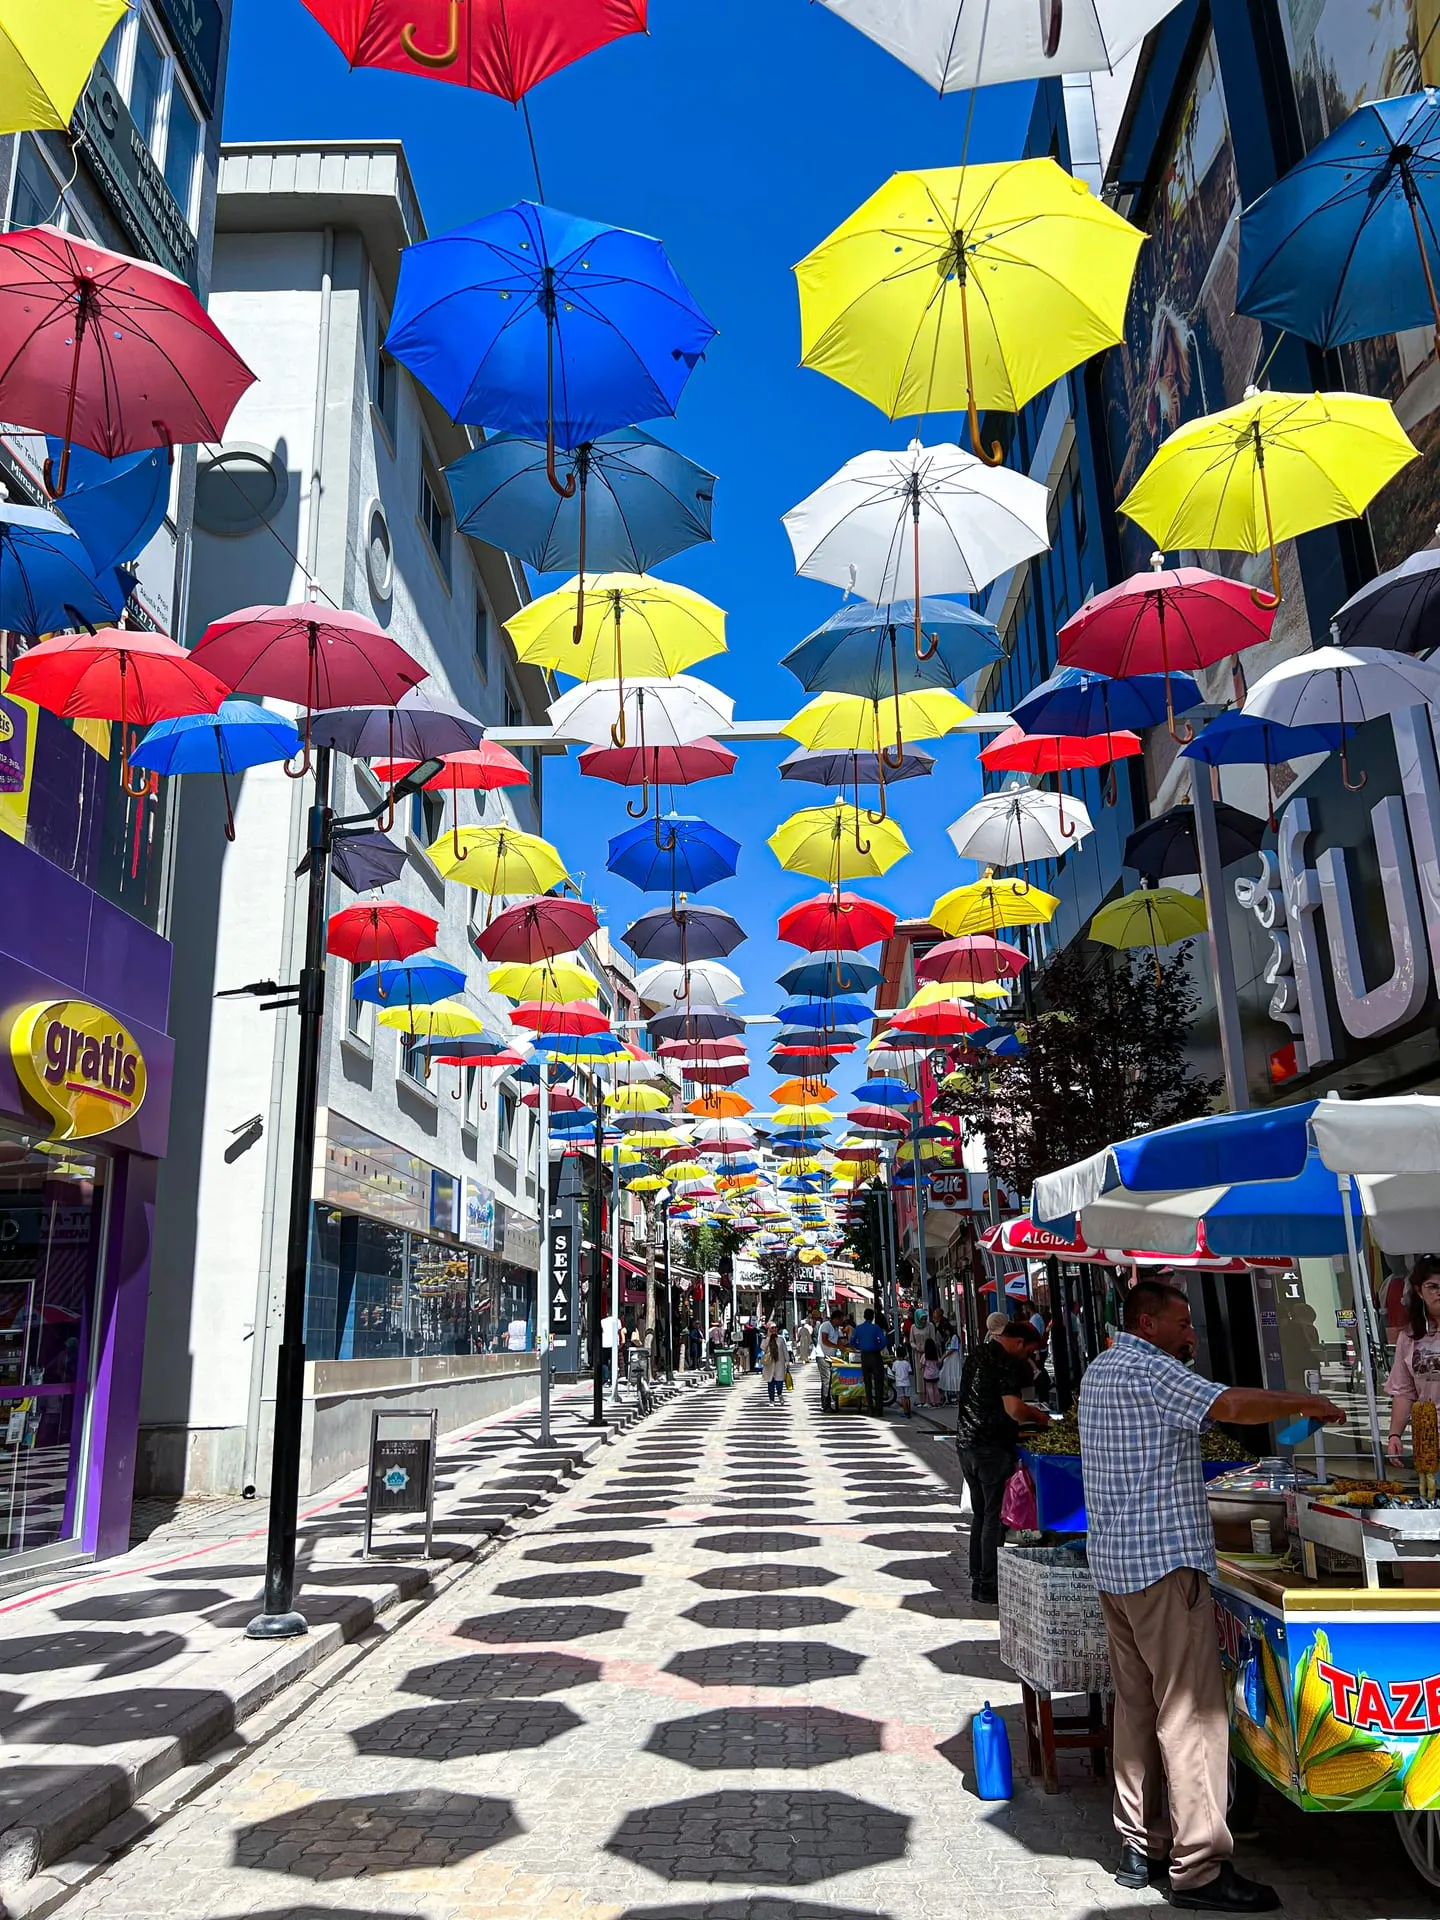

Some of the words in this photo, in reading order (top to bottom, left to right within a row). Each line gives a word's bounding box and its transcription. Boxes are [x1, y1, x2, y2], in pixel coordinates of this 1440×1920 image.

[131, 128, 195, 262] MÜHENDİSLİK
[137, 168, 185, 270] MİMARLIK
[43, 1019, 138, 1097] gratis
[933, 1175, 963, 1193] elit
[553, 1235, 568, 1322] SEVAL
